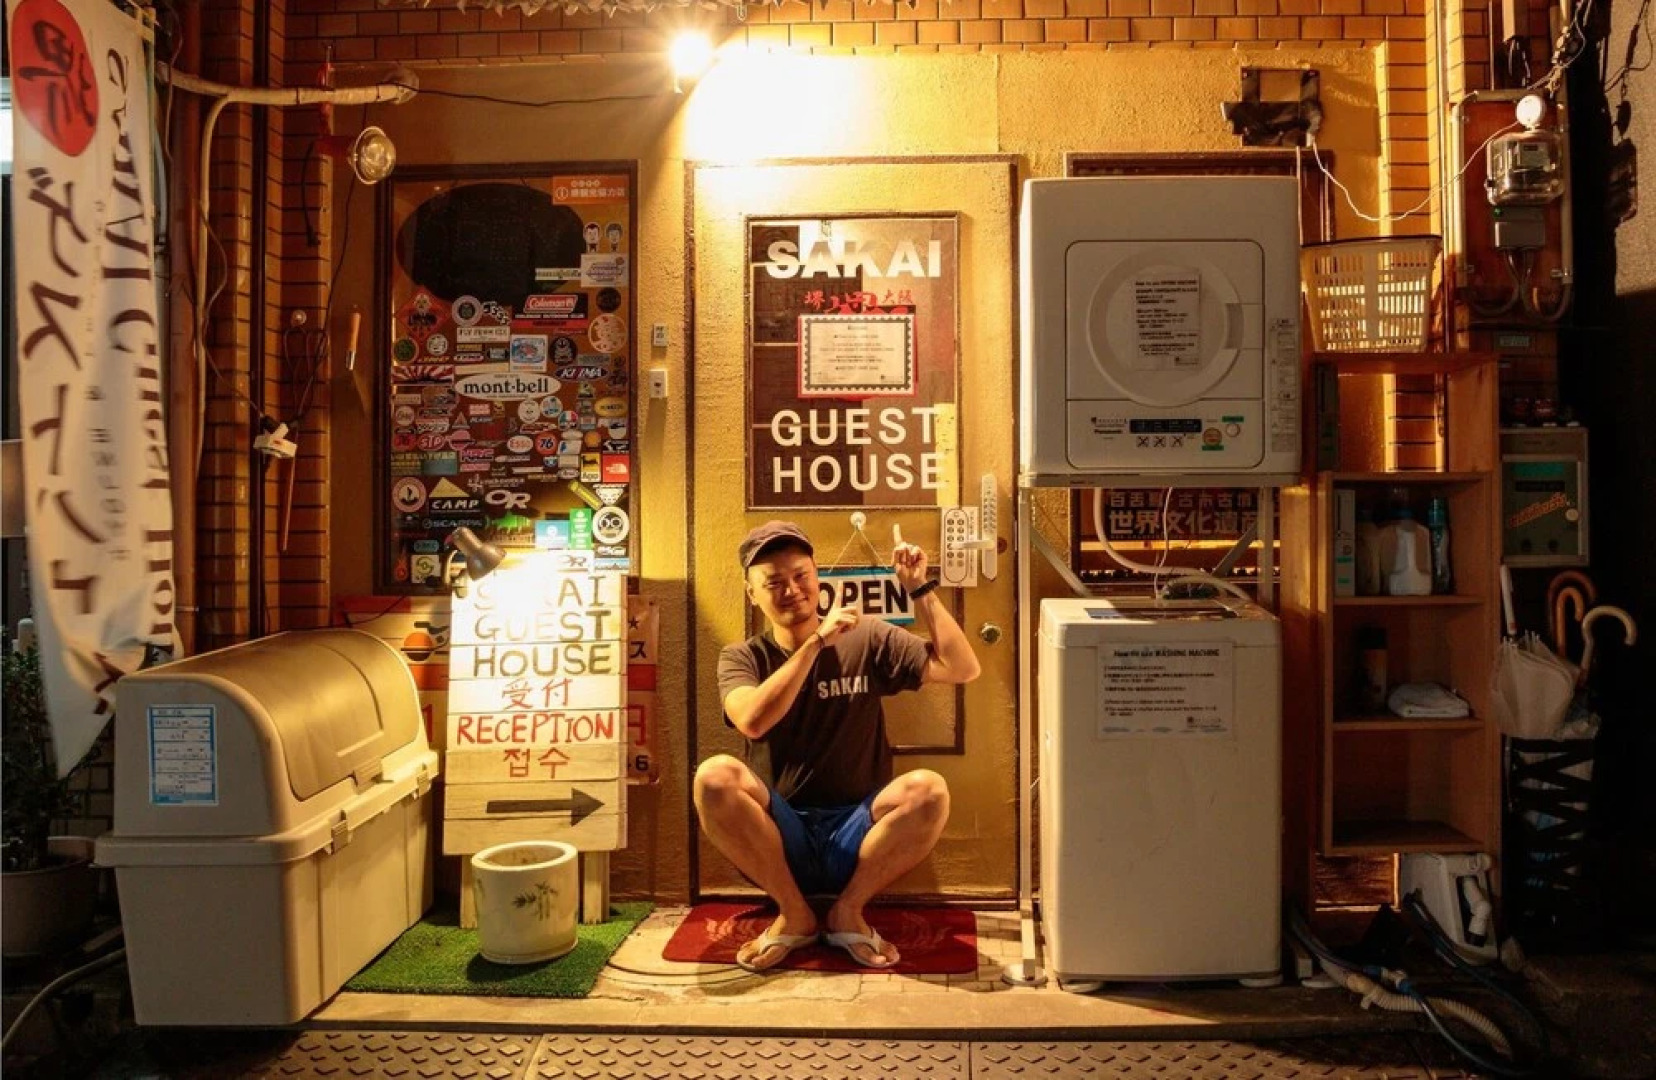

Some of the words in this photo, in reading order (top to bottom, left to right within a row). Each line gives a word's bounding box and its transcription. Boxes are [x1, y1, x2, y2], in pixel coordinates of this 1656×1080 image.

[766, 240, 942, 278] SAKAI
[529, 297, 567, 308] Coleman
[770, 406, 936, 447] GUEST
[541, 439, 553, 448] 76
[772, 453, 949, 493] HOUSE
[431, 500, 479, 509] CAMP
[485, 489, 531, 509] OR
[817, 579, 909, 617] OPEN
[474, 610, 611, 642] GUEST
[473, 644, 611, 676] HOUSE
[502, 677, 573, 710] 受付
[817, 675, 869, 700] SAKAI
[457, 712, 614, 745] RECEPTION
[503, 747, 571, 779] 접수
